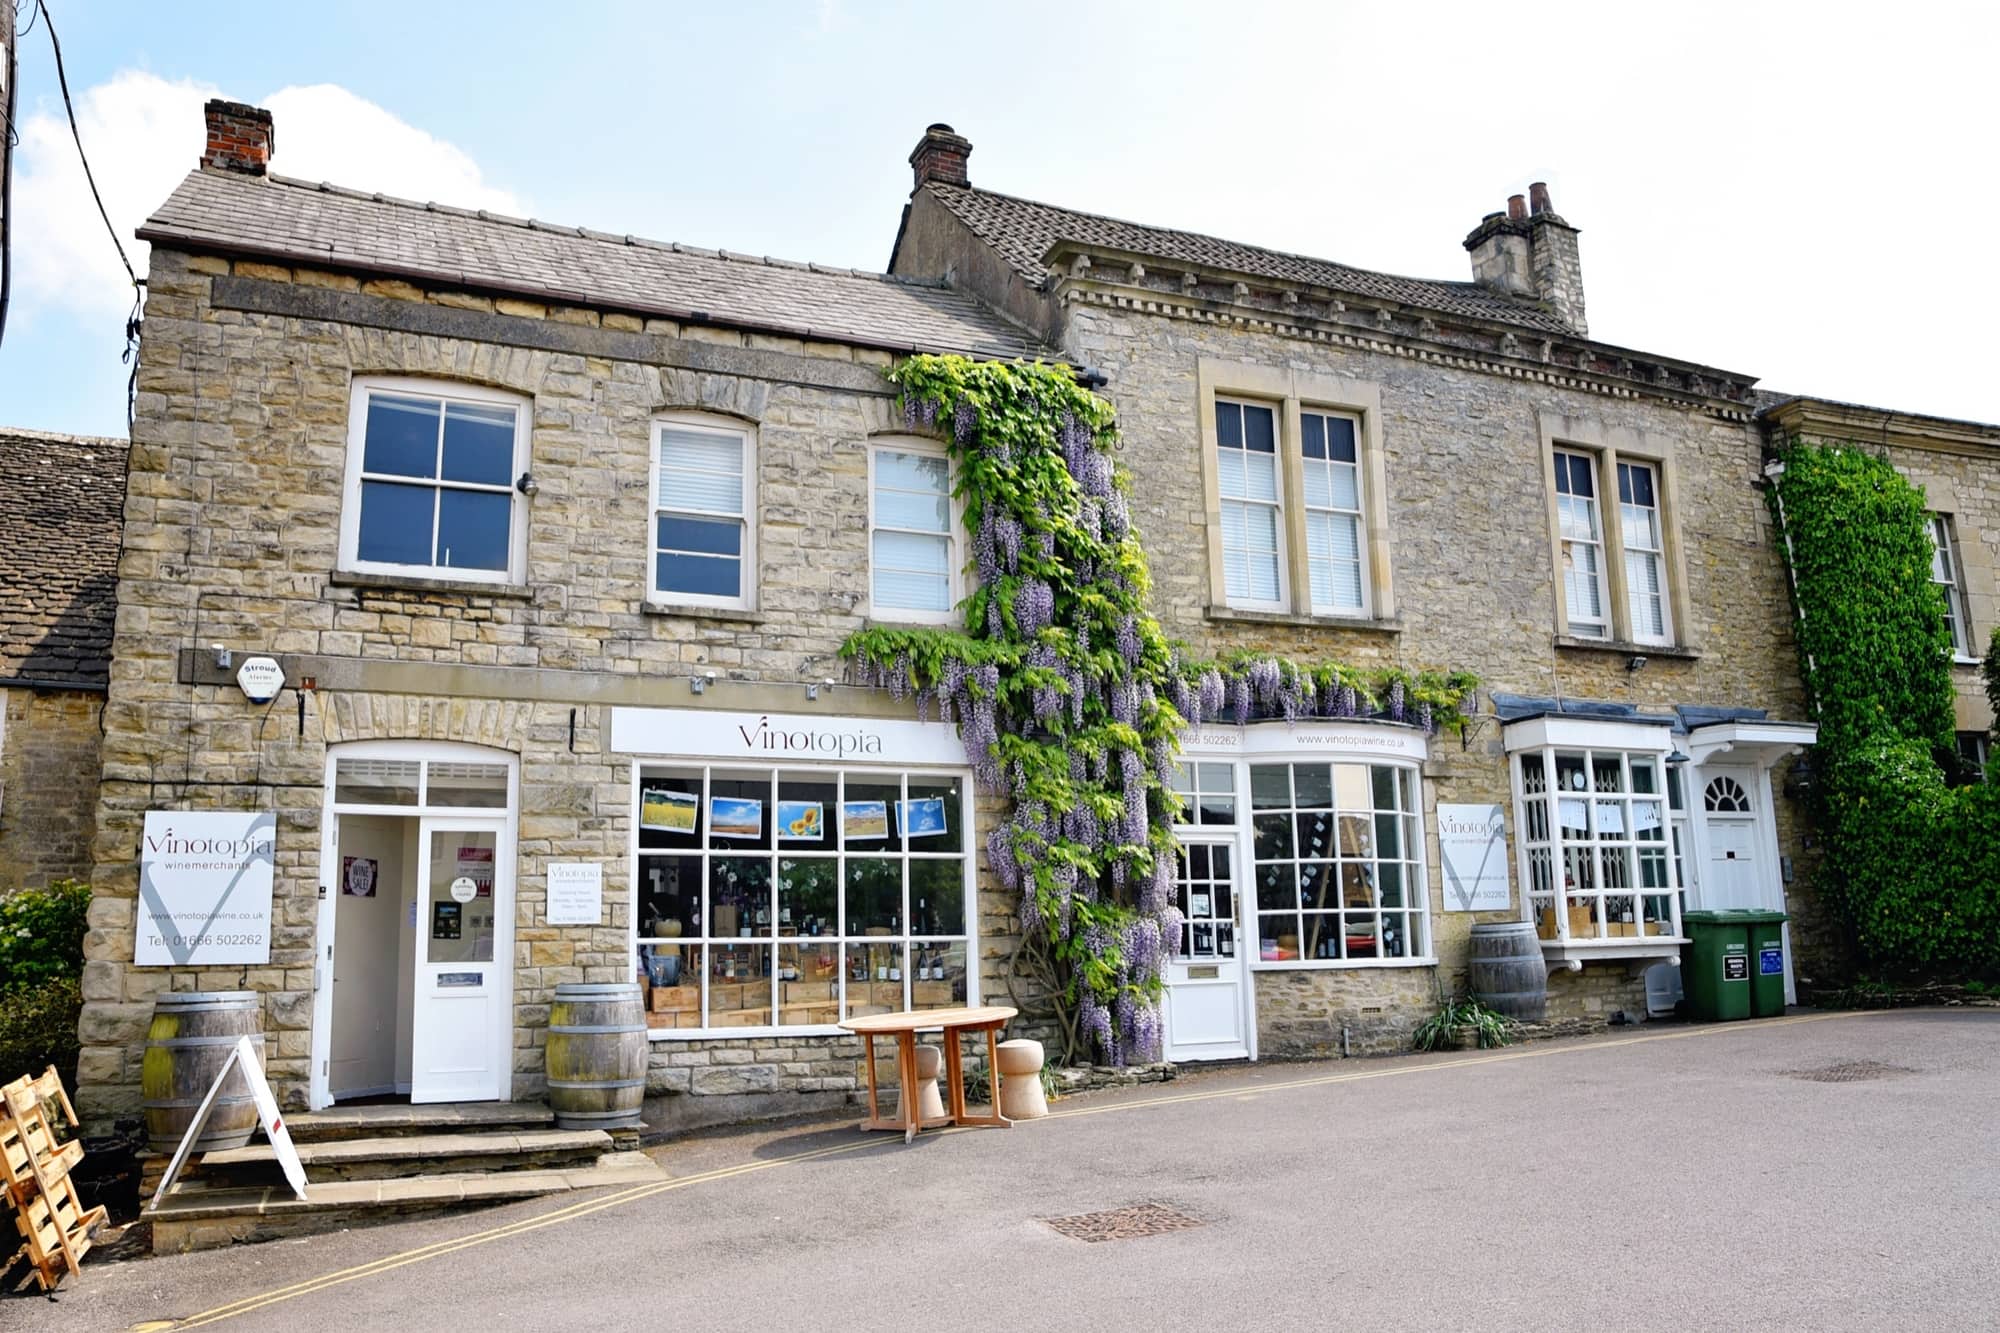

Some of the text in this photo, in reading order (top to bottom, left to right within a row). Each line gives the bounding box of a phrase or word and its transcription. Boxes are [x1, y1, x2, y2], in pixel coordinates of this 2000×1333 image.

[244, 664, 277, 672] Stroud
[738, 715, 882, 758] Vinotopia
[1179, 734, 1237, 745] 1666 502262
[1296, 734, 1406, 748] www.vinotopiawine.co.uk
[1440, 815, 1504, 836] Vinotopia
[147, 827, 271, 859] Vinotopia
[165, 861, 251, 870] winemerchants
[352, 864, 369, 877] WINE
[551, 866, 599, 879] Vinotopia
[147, 911, 264, 921] www.vinotopiawine.co.uk
[147, 934, 262, 946] Tel: 01666 502262
